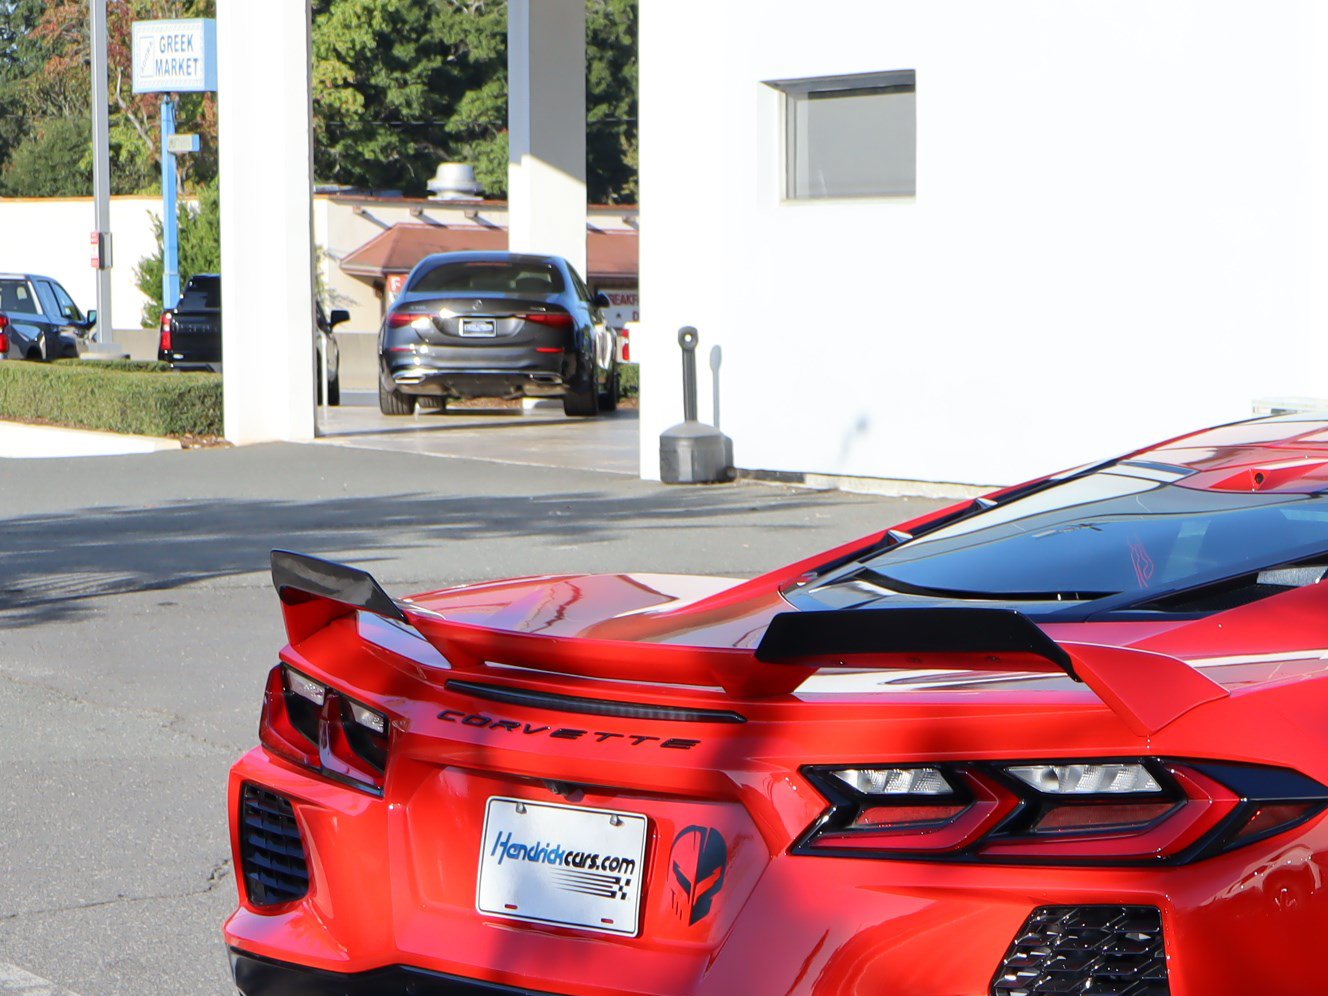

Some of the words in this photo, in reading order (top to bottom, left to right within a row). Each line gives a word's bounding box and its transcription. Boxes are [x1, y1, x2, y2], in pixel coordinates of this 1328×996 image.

[160, 33, 194, 54] GREEK
[155, 57, 199, 77] MARKET
[436, 709, 702, 750] CORVETTE
[490, 830, 636, 876] Hendrickcars.com
